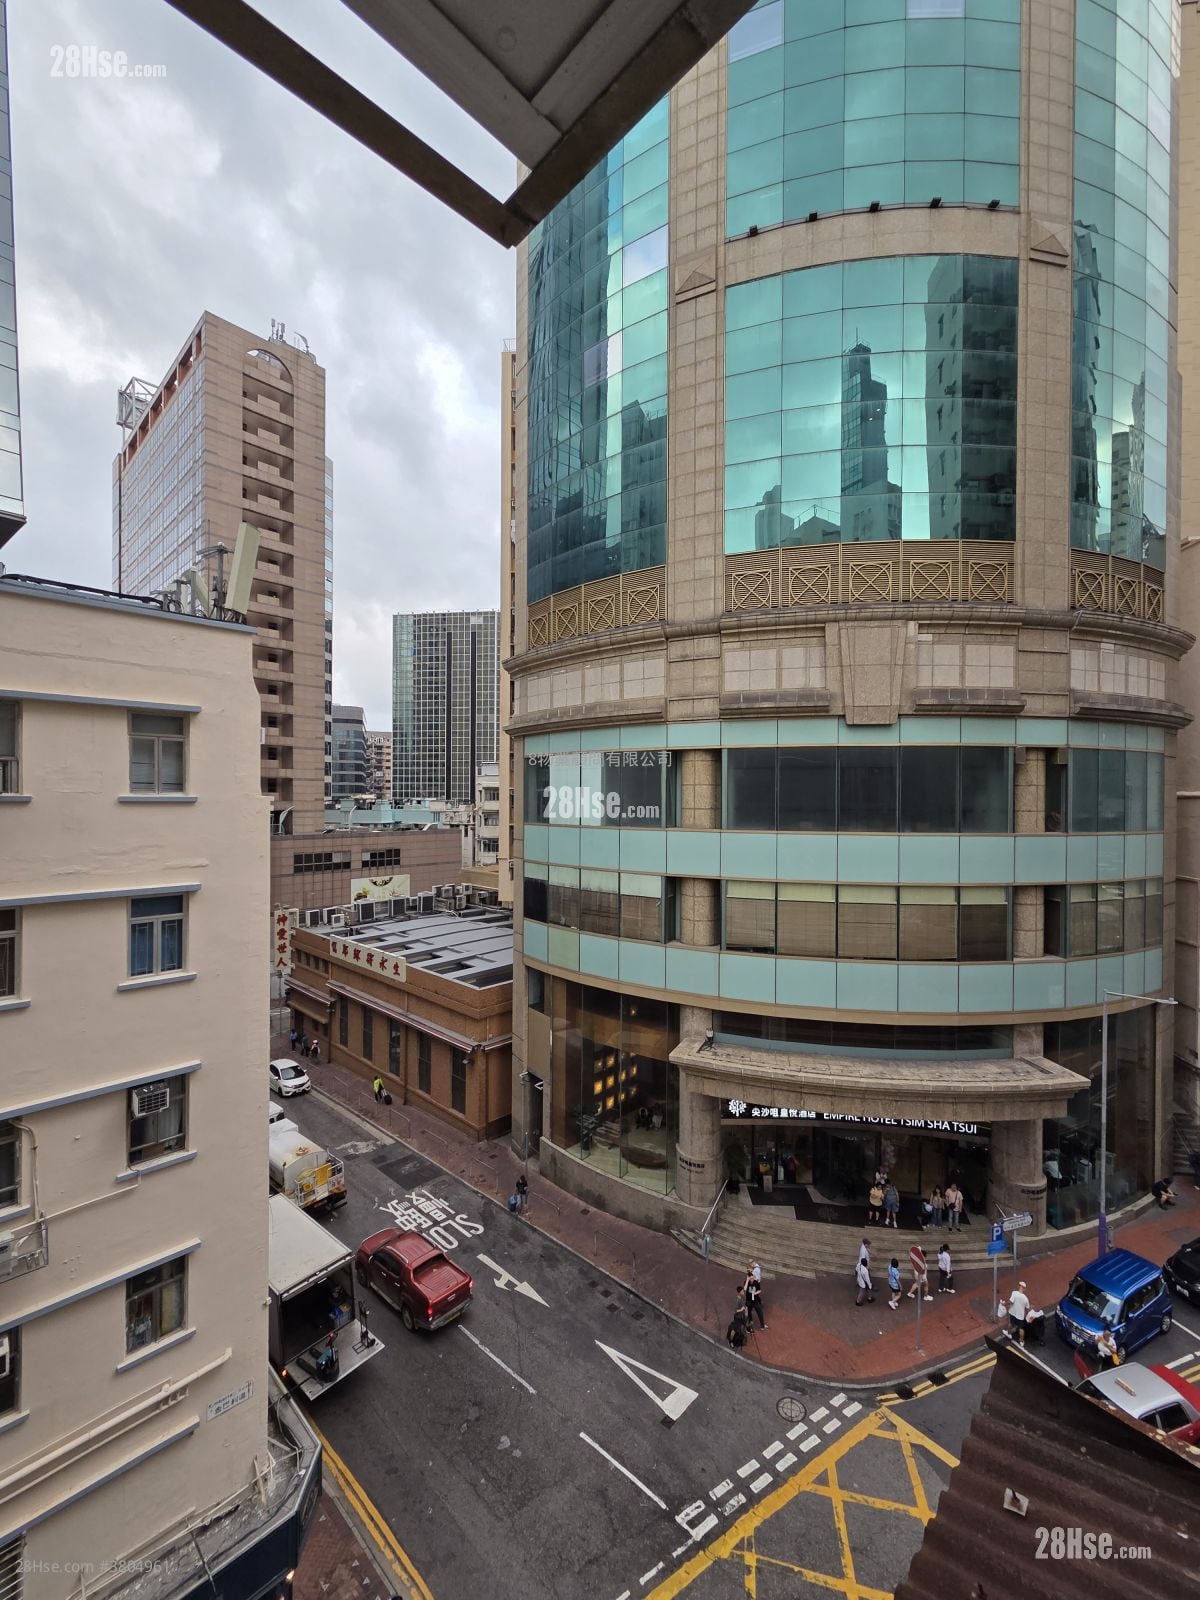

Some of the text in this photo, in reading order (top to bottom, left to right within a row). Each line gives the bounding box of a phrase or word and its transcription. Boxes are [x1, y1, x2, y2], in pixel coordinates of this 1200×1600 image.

[276, 913, 288, 968] 神愛世人
[901, 1118, 925, 1128] TSIM
[927, 1119, 951, 1131] SHA
[952, 1121, 977, 1134] TSUI
[993, 1227, 1001, 1241] P
